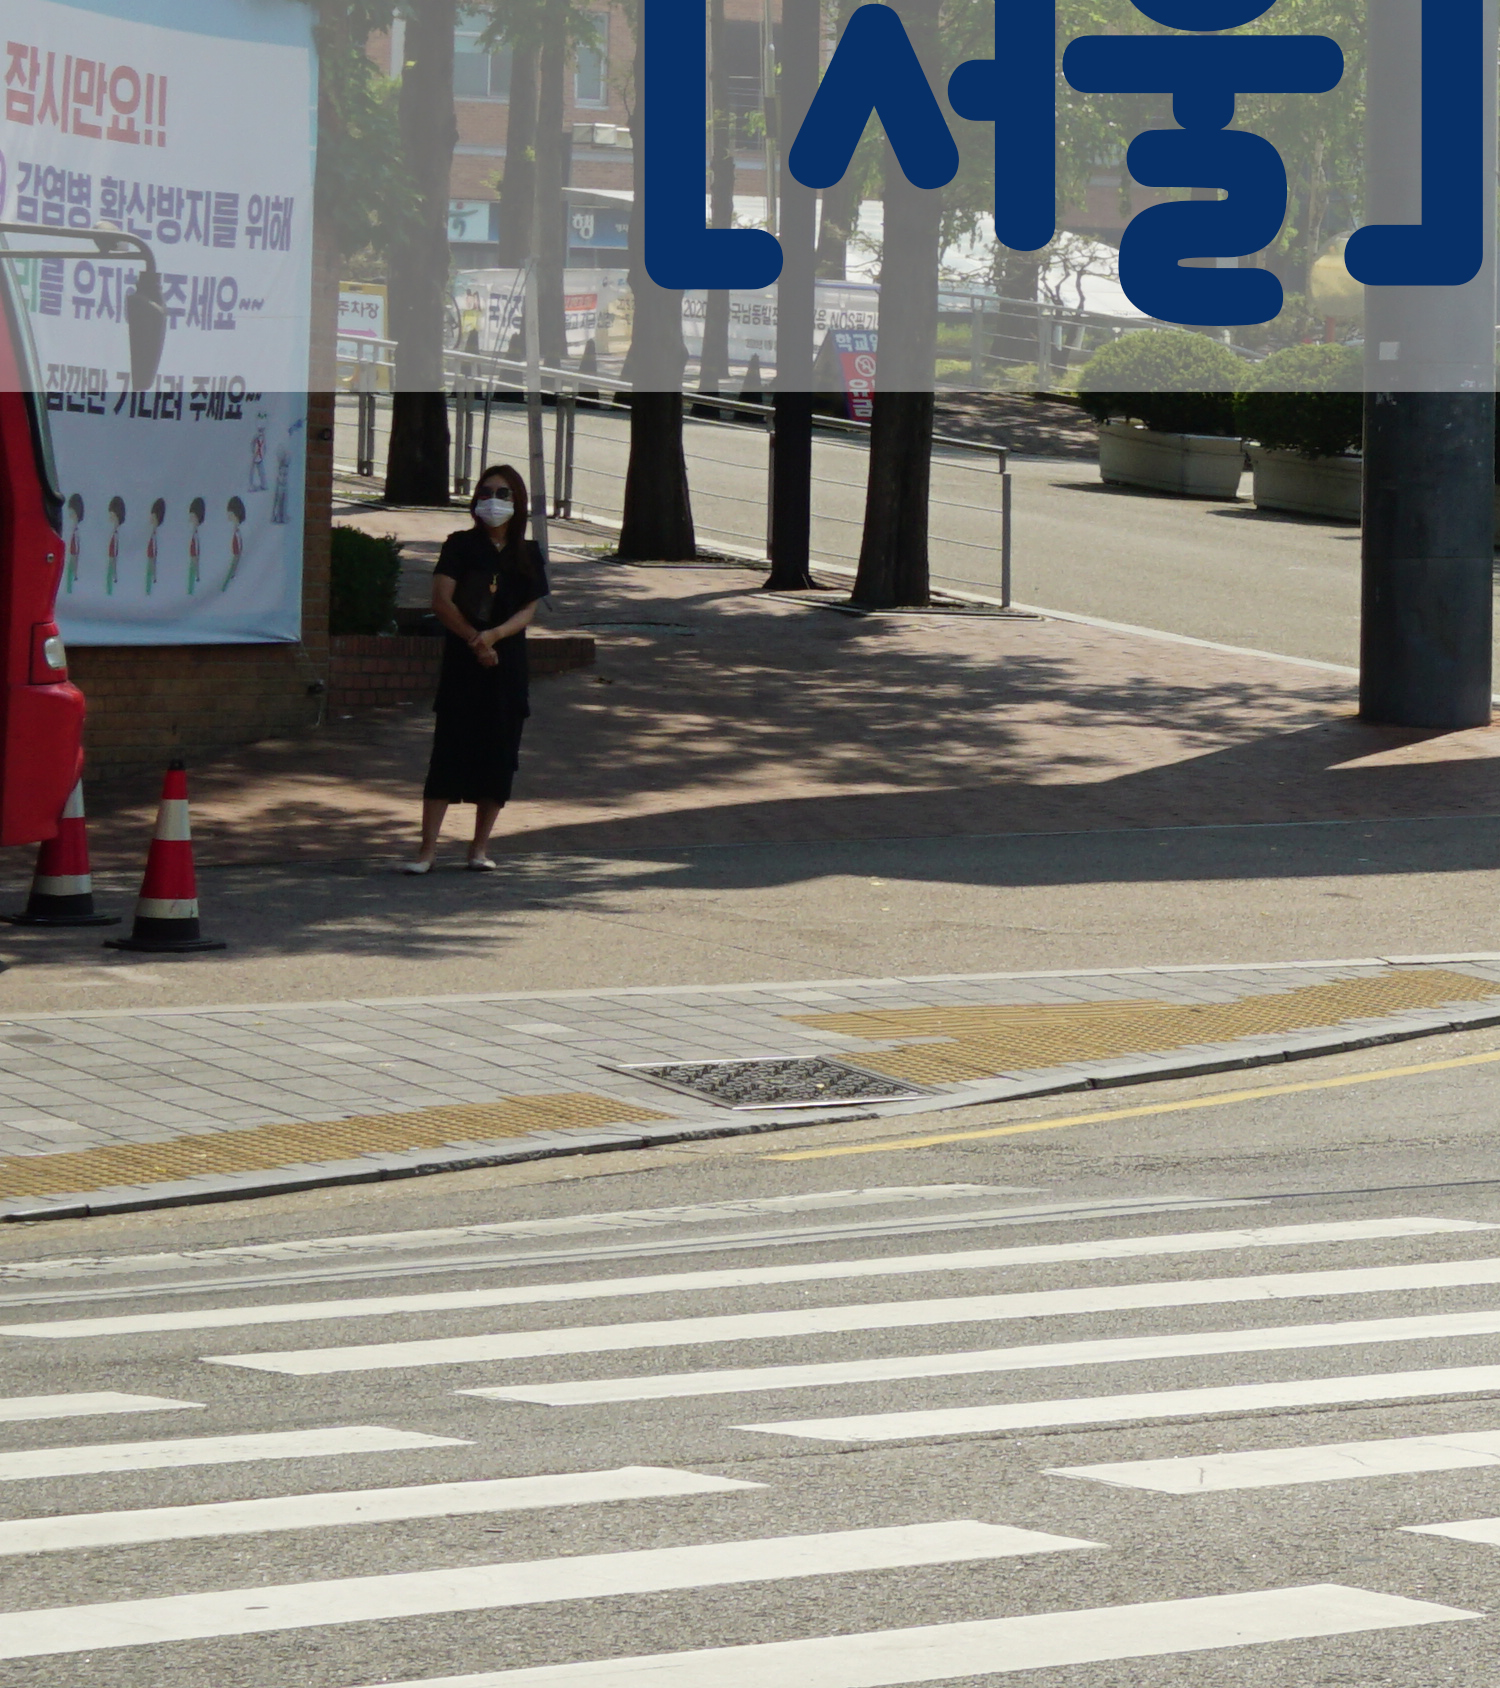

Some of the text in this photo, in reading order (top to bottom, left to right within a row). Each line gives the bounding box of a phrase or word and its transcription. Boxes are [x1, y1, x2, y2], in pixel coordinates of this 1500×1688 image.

[5, 41, 167, 147] 잠시만요!!
[17, 161, 294, 251] 감염병 확산방지를 위해
[338, 300, 380, 319] 주차장
[46, 363, 108, 415] 잠깐만
[114, 372, 184, 420] 기다려
